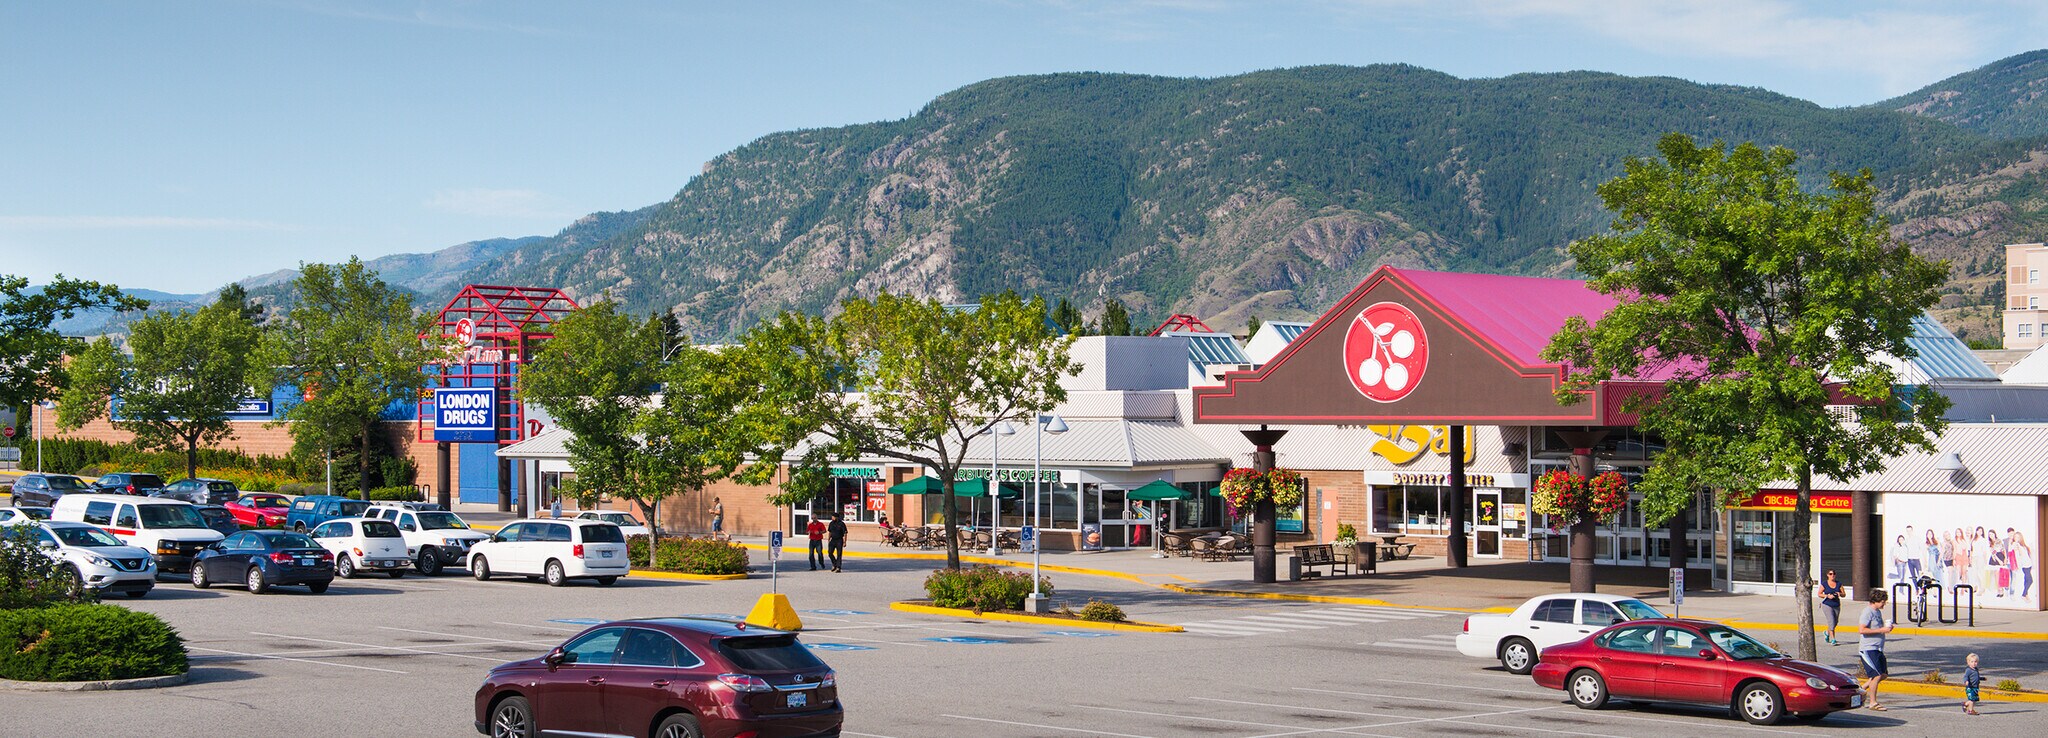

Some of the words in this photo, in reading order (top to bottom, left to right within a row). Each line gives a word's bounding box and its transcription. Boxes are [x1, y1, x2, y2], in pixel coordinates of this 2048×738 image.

[439, 394, 490, 409] LONDON
[443, 410, 486, 425] DRUGS
[935, 468, 1008, 481] RBUCKS
[1393, 472, 1445, 485] Booster
[1763, 496, 1782, 505] CIBC
[1784, 496, 1817, 508] Bang
[1819, 497, 1849, 507] Centre
